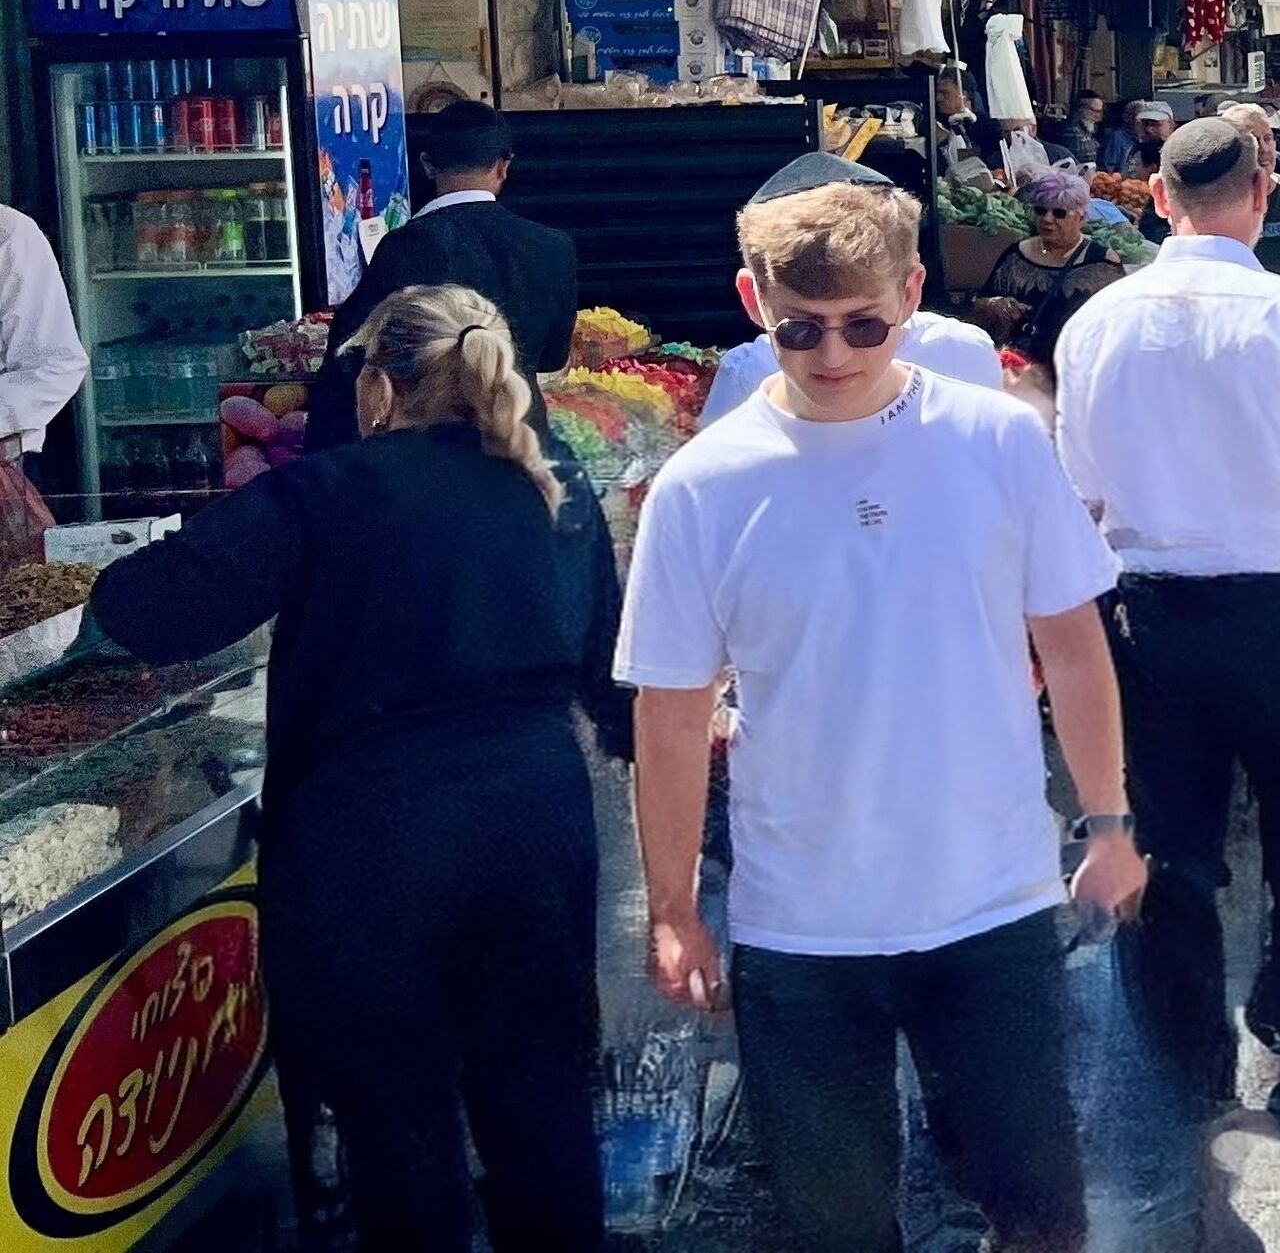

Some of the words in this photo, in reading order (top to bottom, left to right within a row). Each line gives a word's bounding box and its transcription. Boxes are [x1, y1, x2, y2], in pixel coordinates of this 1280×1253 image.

[315, 1, 393, 53] שתיה
[331, 82, 390, 145] קרה
[889, 399, 908, 421] AM
[907, 377, 921, 400] THE
